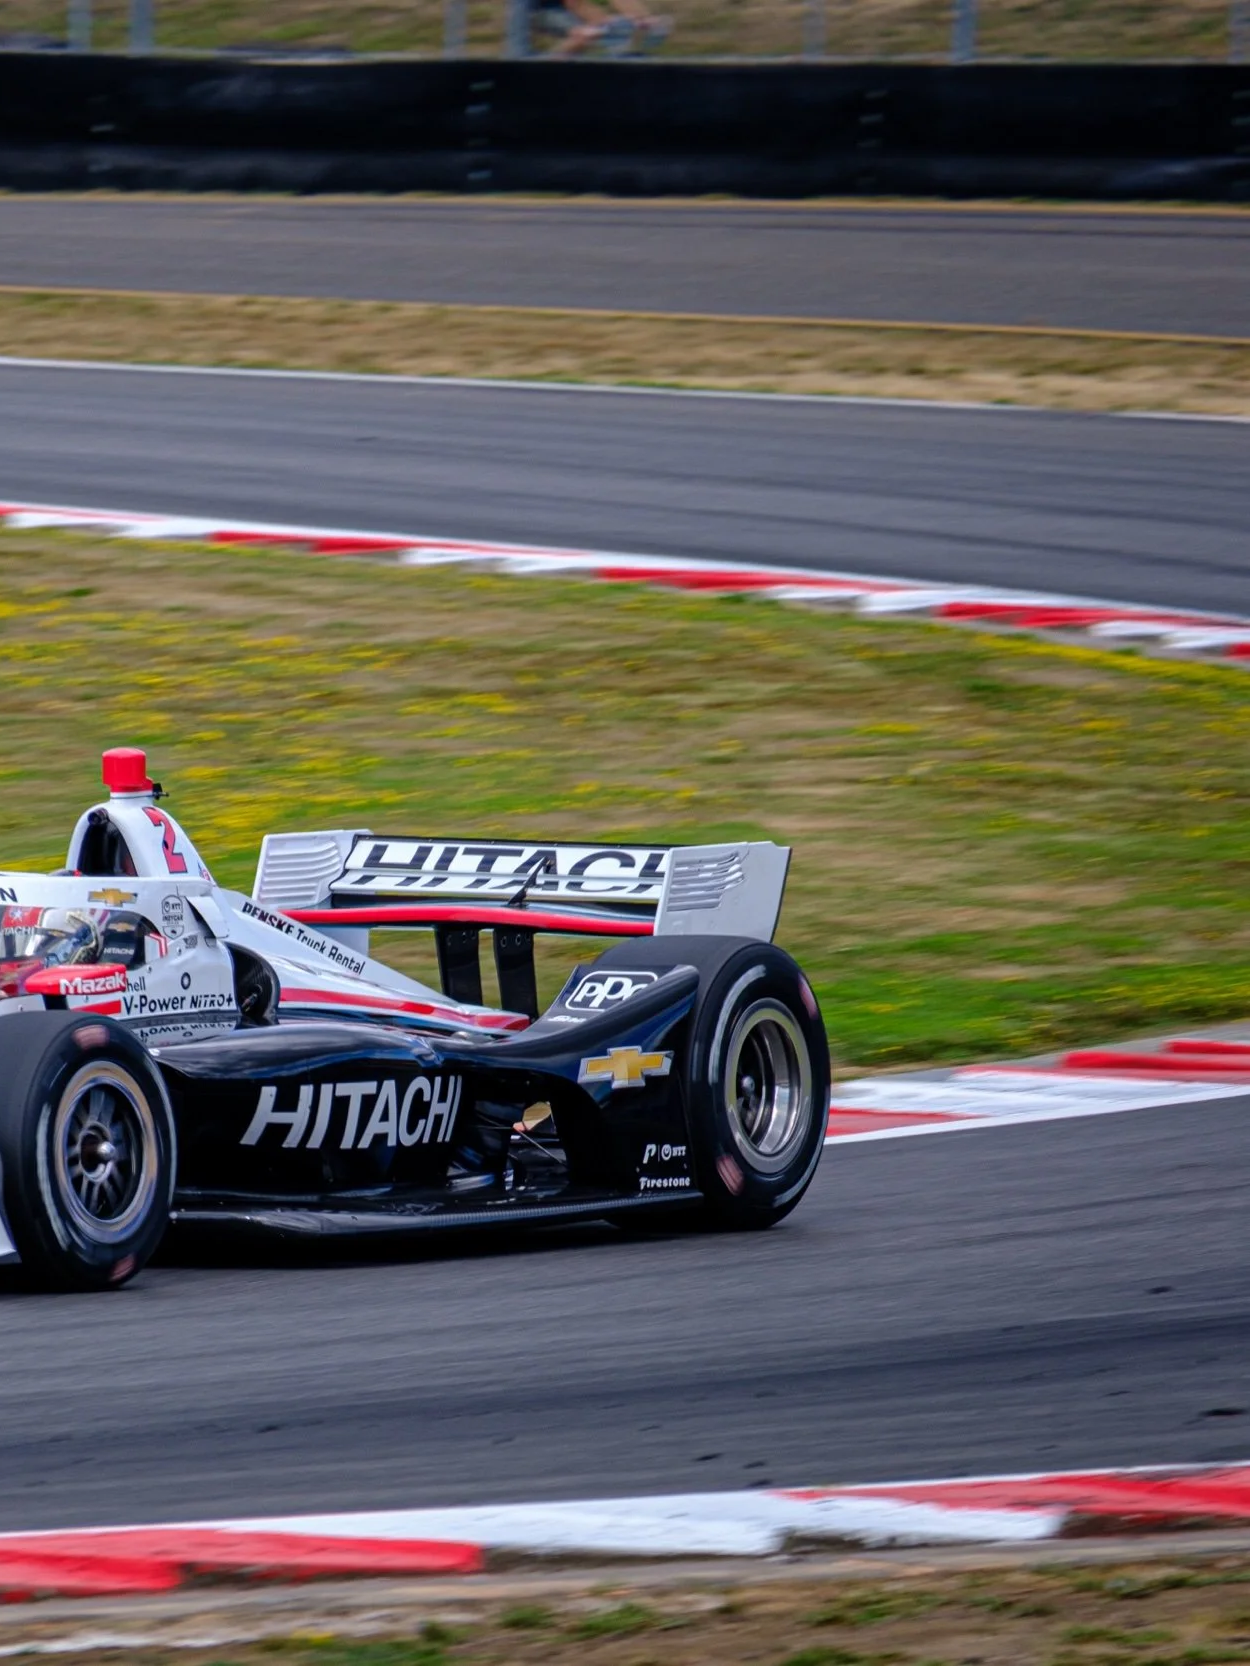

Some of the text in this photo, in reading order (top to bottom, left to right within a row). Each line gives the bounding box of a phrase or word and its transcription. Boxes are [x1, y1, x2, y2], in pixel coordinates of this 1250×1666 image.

[142, 806, 188, 873] 2
[242, 902, 294, 935] PENSKE
[103, 947, 135, 956] HITACHI
[296, 928, 365, 975] Truck Rental
[59, 972, 127, 995] Mazak
[125, 976, 146, 992] hell
[123, 993, 186, 1015] V-Power
[239, 1075, 462, 1149] HITACHI
[639, 1177, 690, 1190] Firestone
